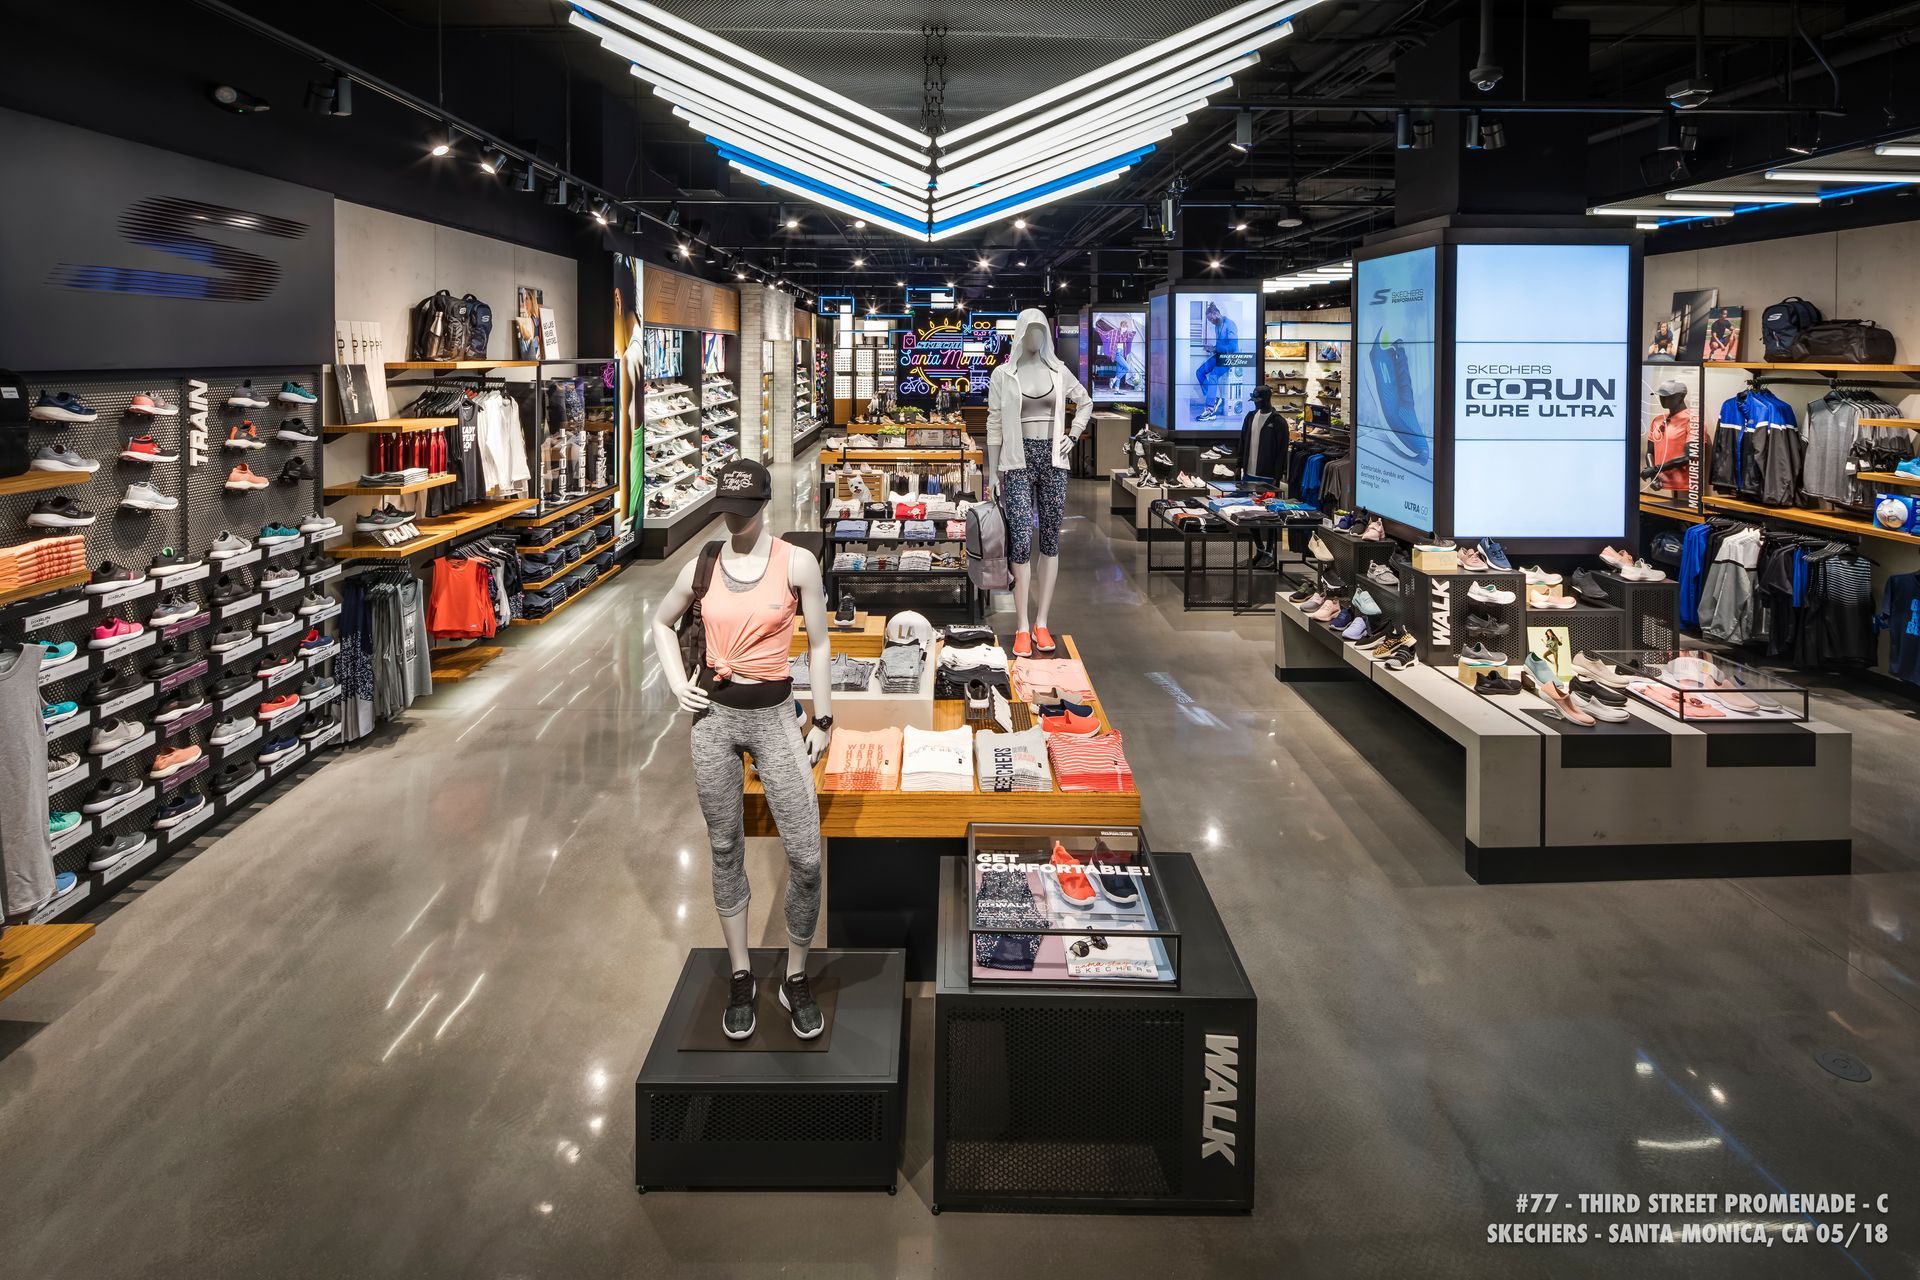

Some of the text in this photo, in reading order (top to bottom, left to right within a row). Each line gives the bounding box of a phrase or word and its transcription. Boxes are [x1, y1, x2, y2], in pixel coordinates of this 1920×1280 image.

[900, 349, 996, 369] Santa Monica
[1467, 364, 1552, 375] SKECHERS
[1466, 378, 1616, 401] GORUN
[1465, 404, 1530, 418] PURE
[188, 379, 209, 467] TRAIN
[1688, 459, 1700, 509] MOISTURE
[1404, 500, 1420, 514] ULTRA
[384, 521, 421, 548] RUN
[1430, 576, 1452, 646] WALK
[846, 749, 884, 759] HARD
[845, 758, 883, 768] STAY
[976, 853, 1020, 863] GET
[976, 862, 1151, 877] COMFORTABLE!
[1200, 1033, 1240, 1168] WALK
